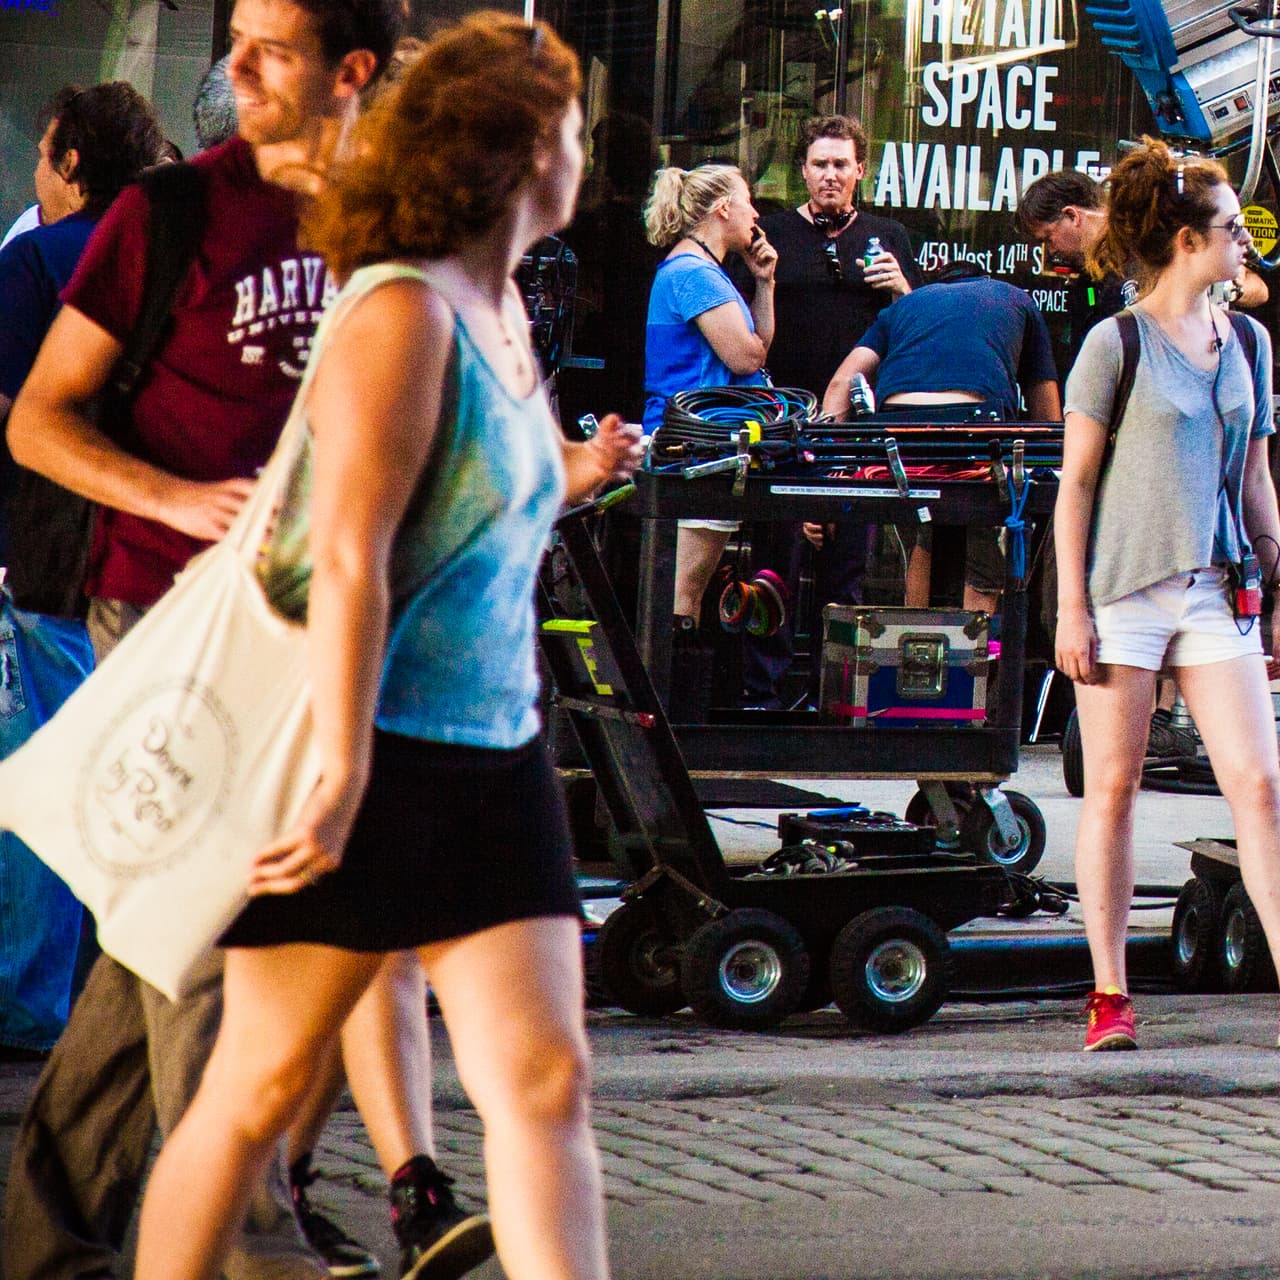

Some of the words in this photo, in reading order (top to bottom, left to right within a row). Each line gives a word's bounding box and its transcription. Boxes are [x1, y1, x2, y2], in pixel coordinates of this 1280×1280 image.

[922, 62, 1058, 131] SPACE
[874, 142, 1100, 212] AVAILAB
[1245, 216, 1275, 225] TOMATIC
[953, 243, 993, 274] West
[997, 243, 1028, 274] 14TH
[1032, 246, 1043, 276] S
[1032, 290, 1069, 313] SPACE
